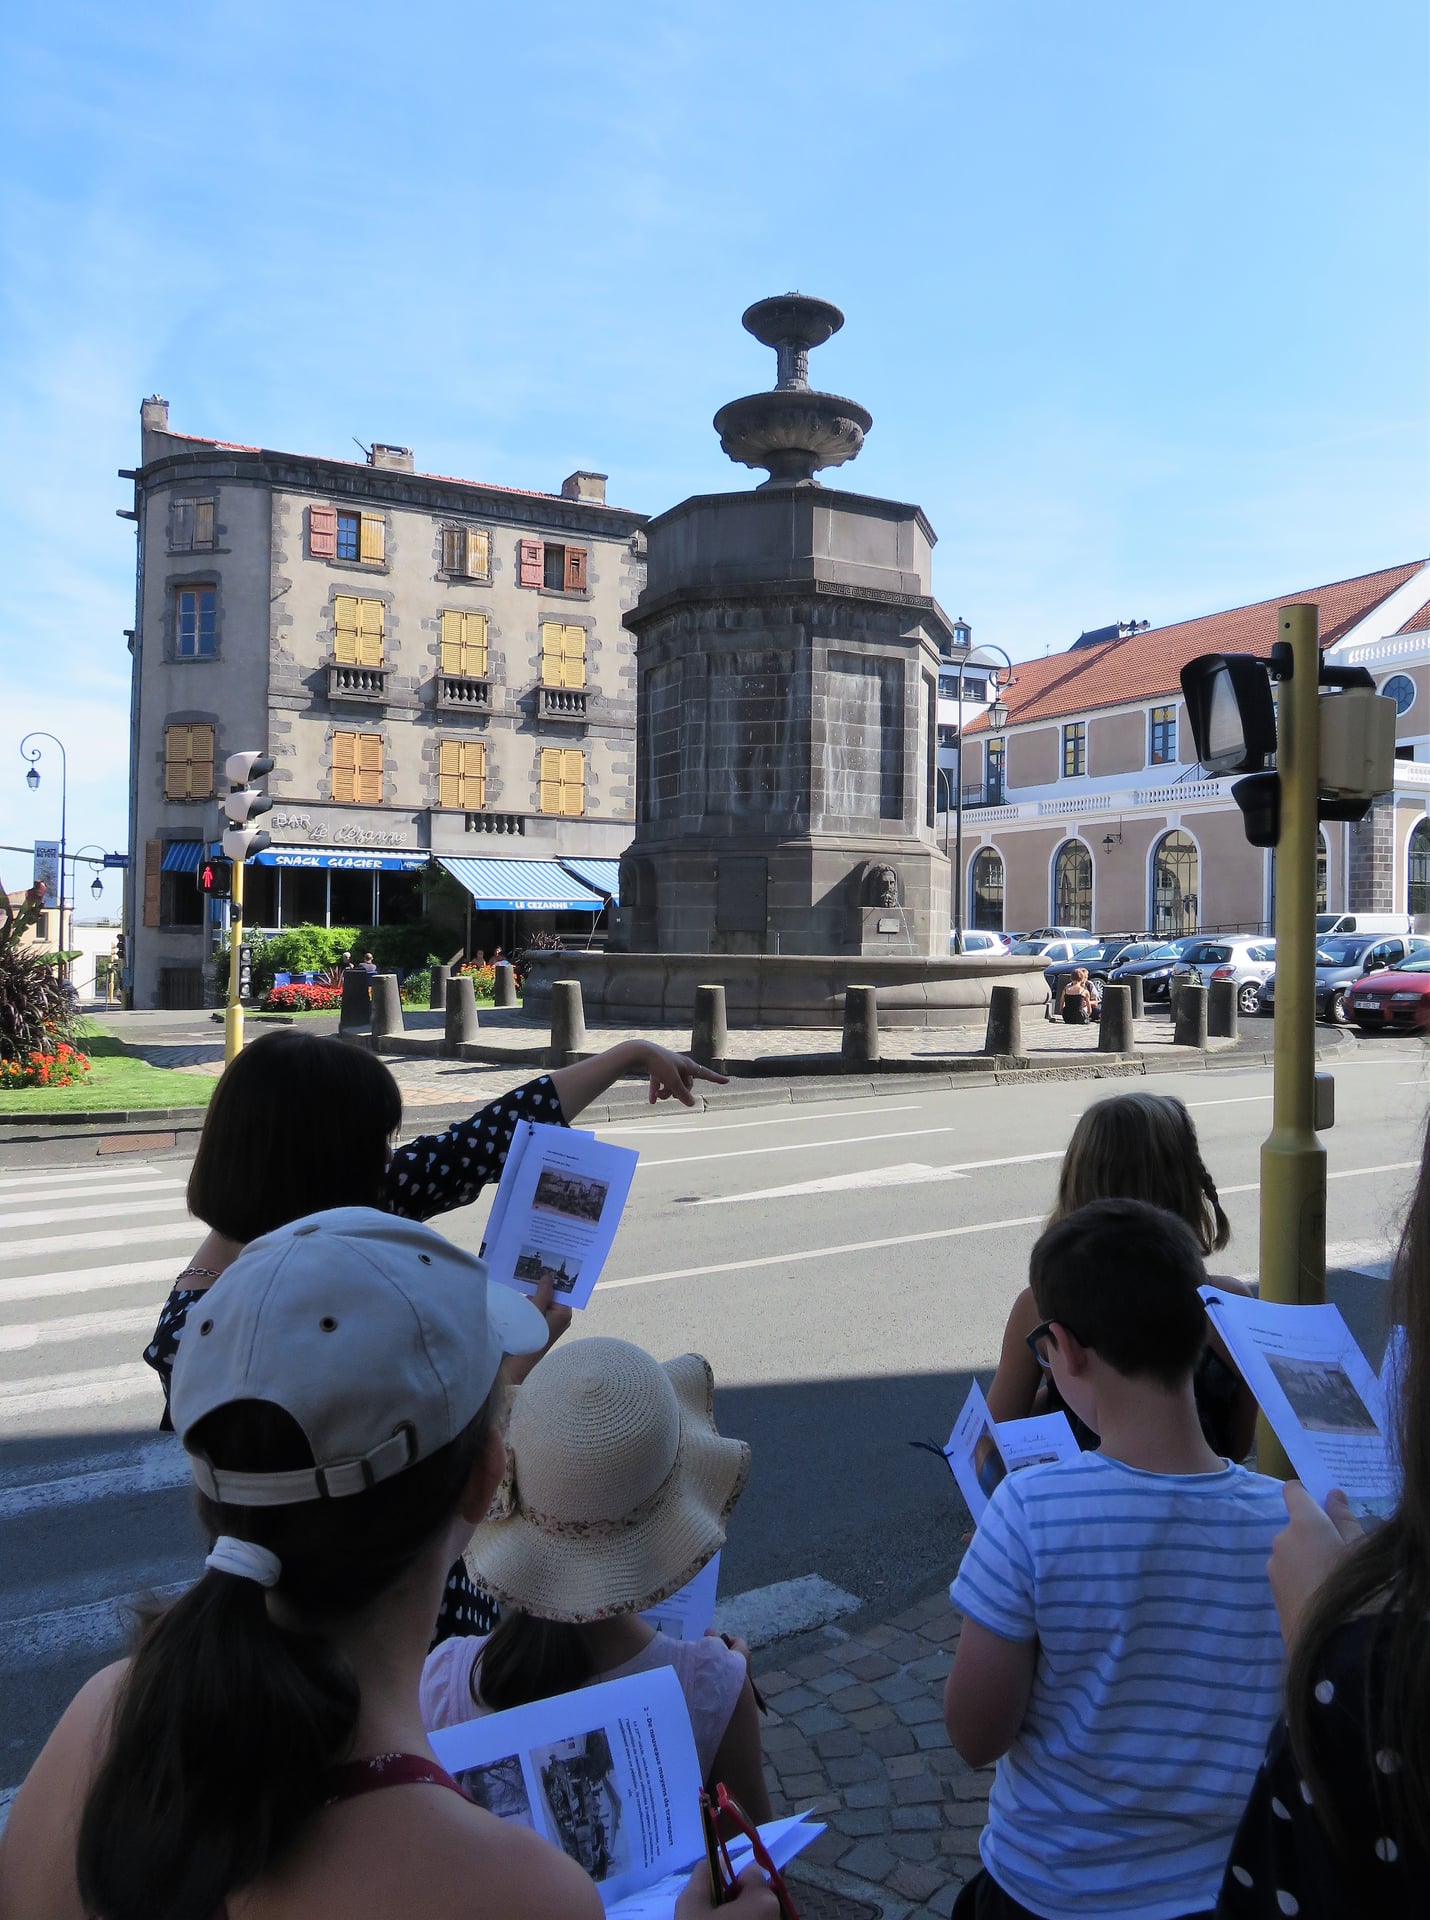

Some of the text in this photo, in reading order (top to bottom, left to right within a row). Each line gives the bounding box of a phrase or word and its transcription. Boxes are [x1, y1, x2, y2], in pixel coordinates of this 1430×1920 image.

[276, 812, 311, 826] BAR
[311, 822, 328, 839] Le
[275, 855, 383, 869] SNACK GLACIER
[514, 901, 569, 910] LE CEZANNE
[646, 1718, 652, 1728] De
[650, 1728, 660, 1766] nouveaux
[658, 1766, 668, 1798] moyens
[664, 1798, 670, 1808] de
[666, 1808, 674, 1846] transport
